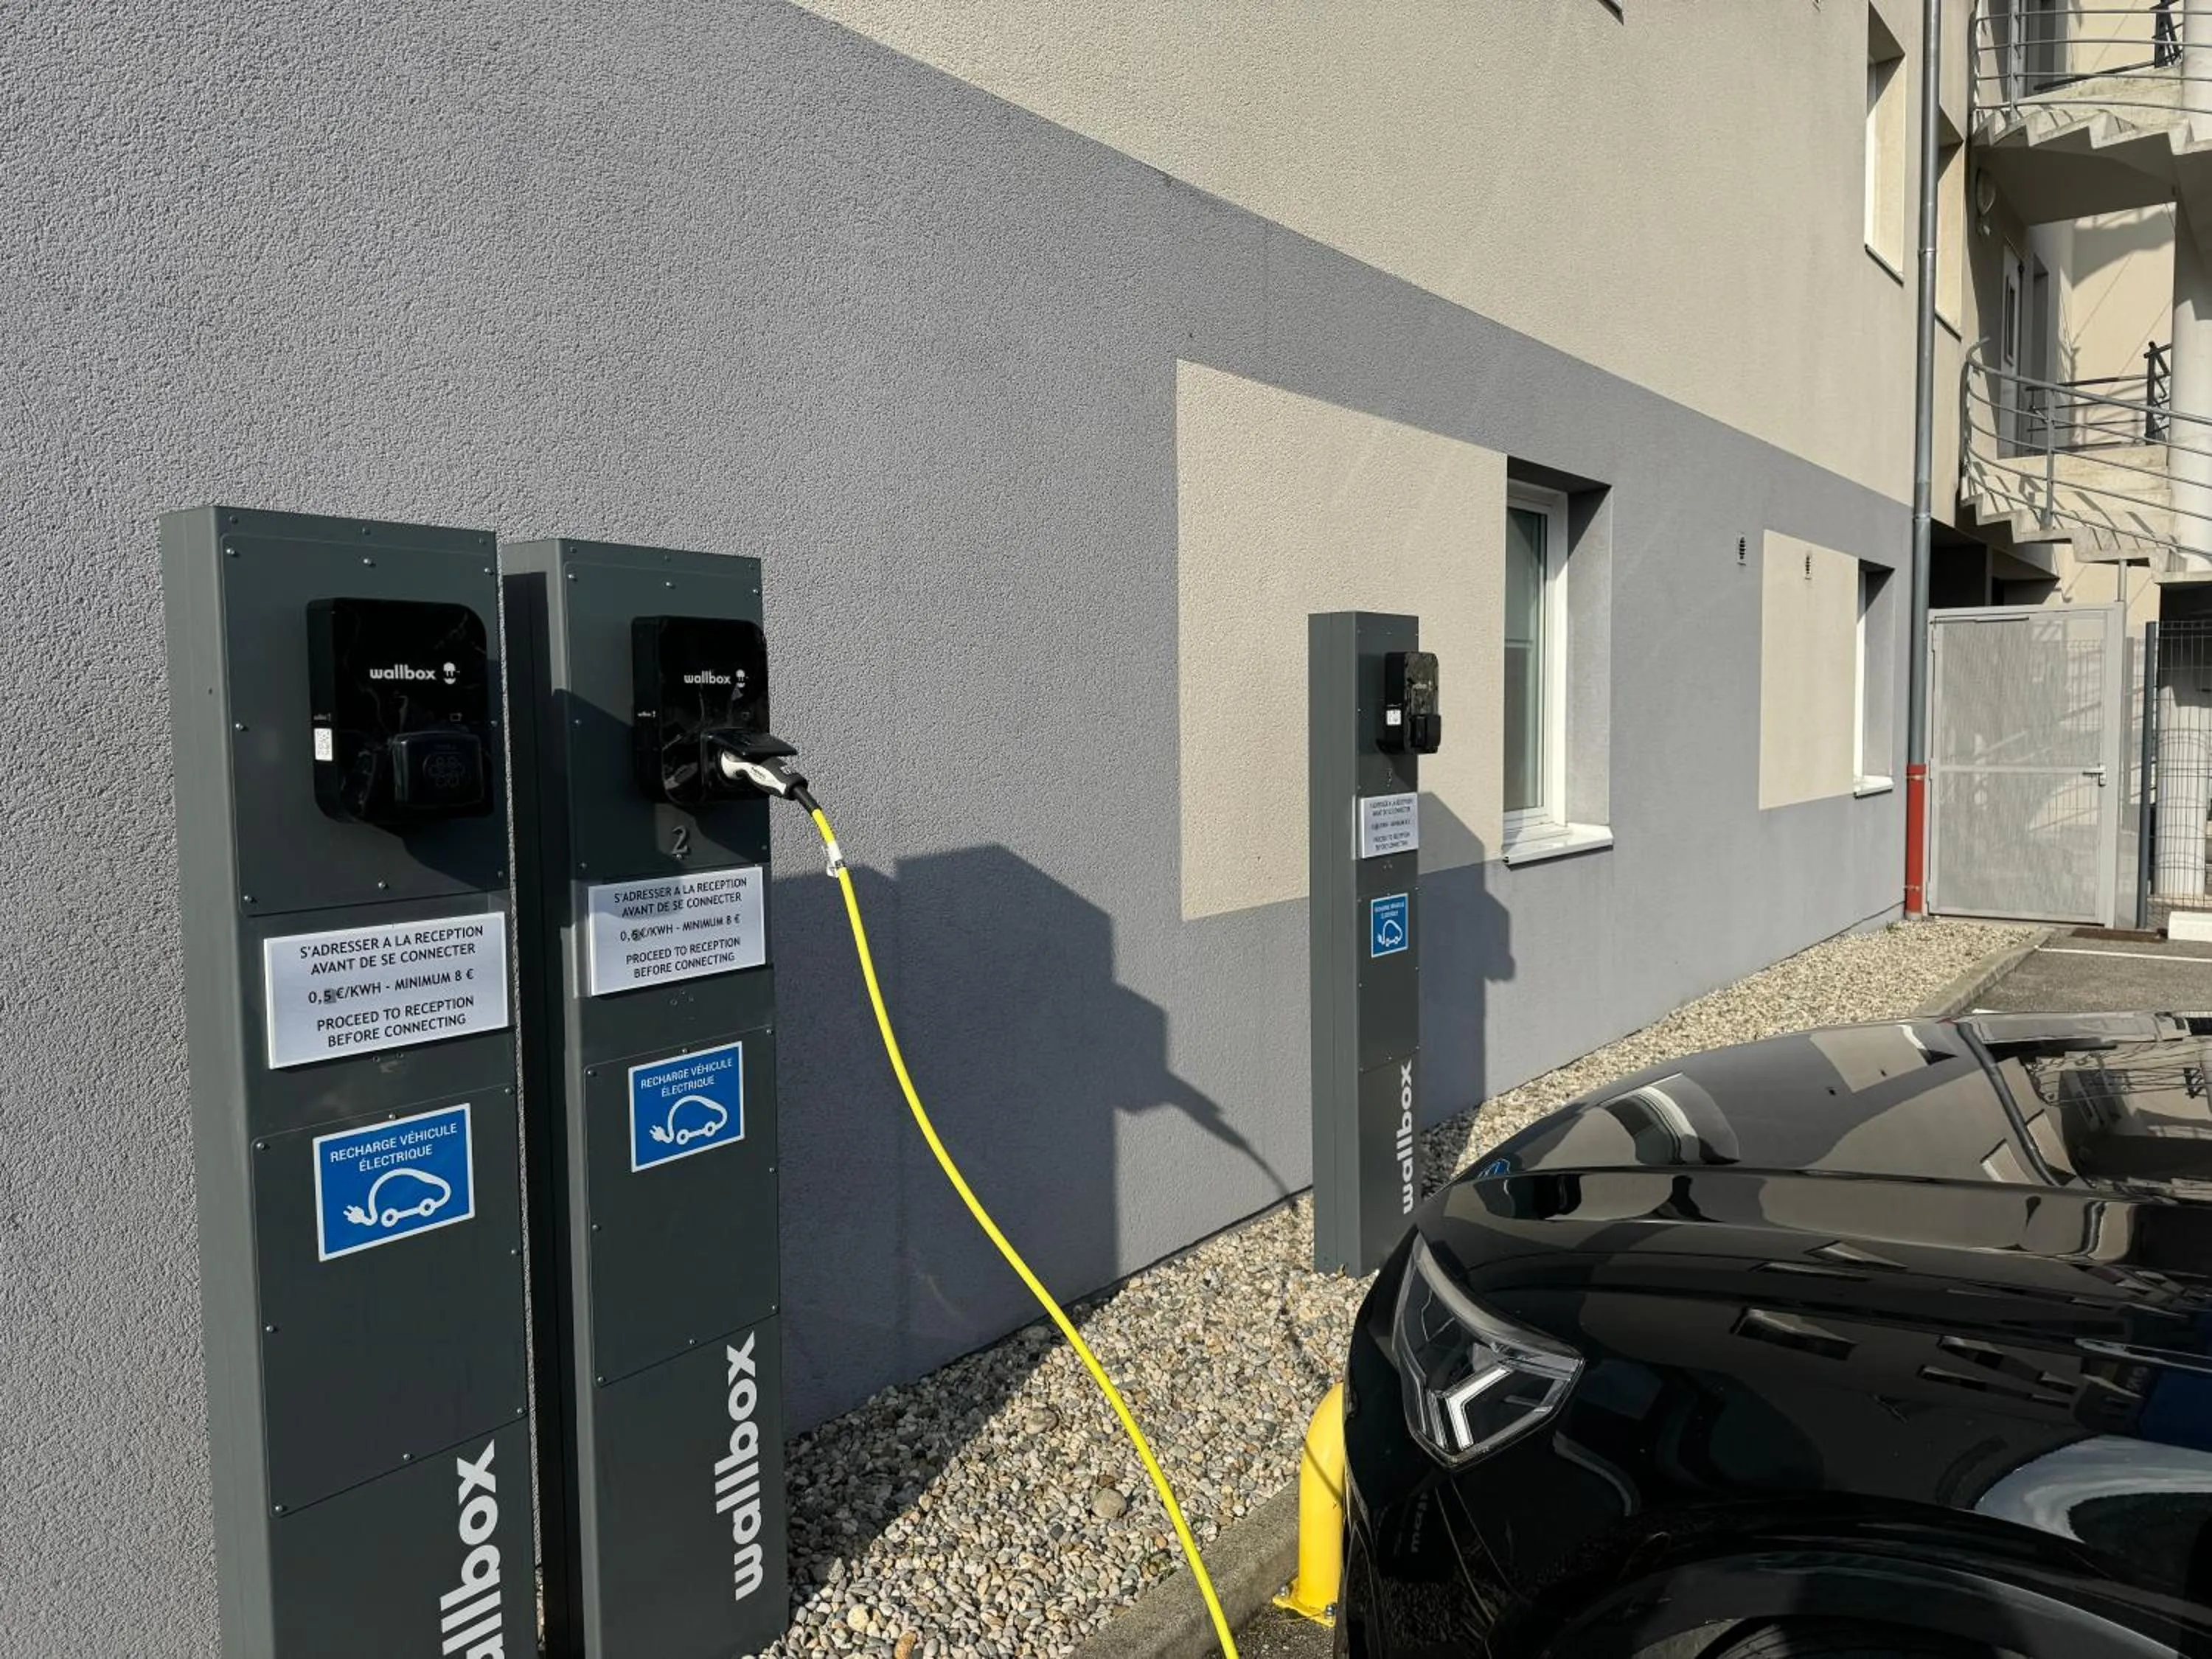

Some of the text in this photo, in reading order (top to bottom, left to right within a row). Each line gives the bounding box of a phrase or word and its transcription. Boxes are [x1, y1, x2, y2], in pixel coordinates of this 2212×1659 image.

[369, 664, 437, 681] wallbox
[684, 670, 731, 685] wallbox
[672, 825, 689, 854] 2
[614, 877, 747, 903] S'ADRESSER A LA RECEPTION
[622, 891, 742, 918] AVANT DE SE CONNECTER
[682, 916, 723, 931] MINIMUM
[734, 914, 740, 923] €
[300, 925, 484, 959] S'ADRESSER A LA RECEPTION
[626, 936, 741, 964] PROCEED TO RECEPTION
[310, 942, 476, 975] AVANT DE SE CONNECTER
[634, 951, 735, 978] BEFORE CONNECTING
[394, 971, 451, 991] MINIMUM
[454, 970, 462, 981] 8
[466, 968, 474, 979] €
[317, 996, 474, 1032] PROCEED TO RECEPTION
[328, 1013, 466, 1048] BEFORE CONNECTING
[641, 1058, 733, 1089] RECHARGE VÉHICULE
[661, 1076, 715, 1098] ÉLECTRIQUE
[330, 1123, 458, 1163] RECHARGE VÉHICULE
[1397, 1059, 1413, 1214] wallbox
[359, 1144, 433, 1172] ÉLECTRIQUE
[714, 1330, 763, 1601] wallbox
